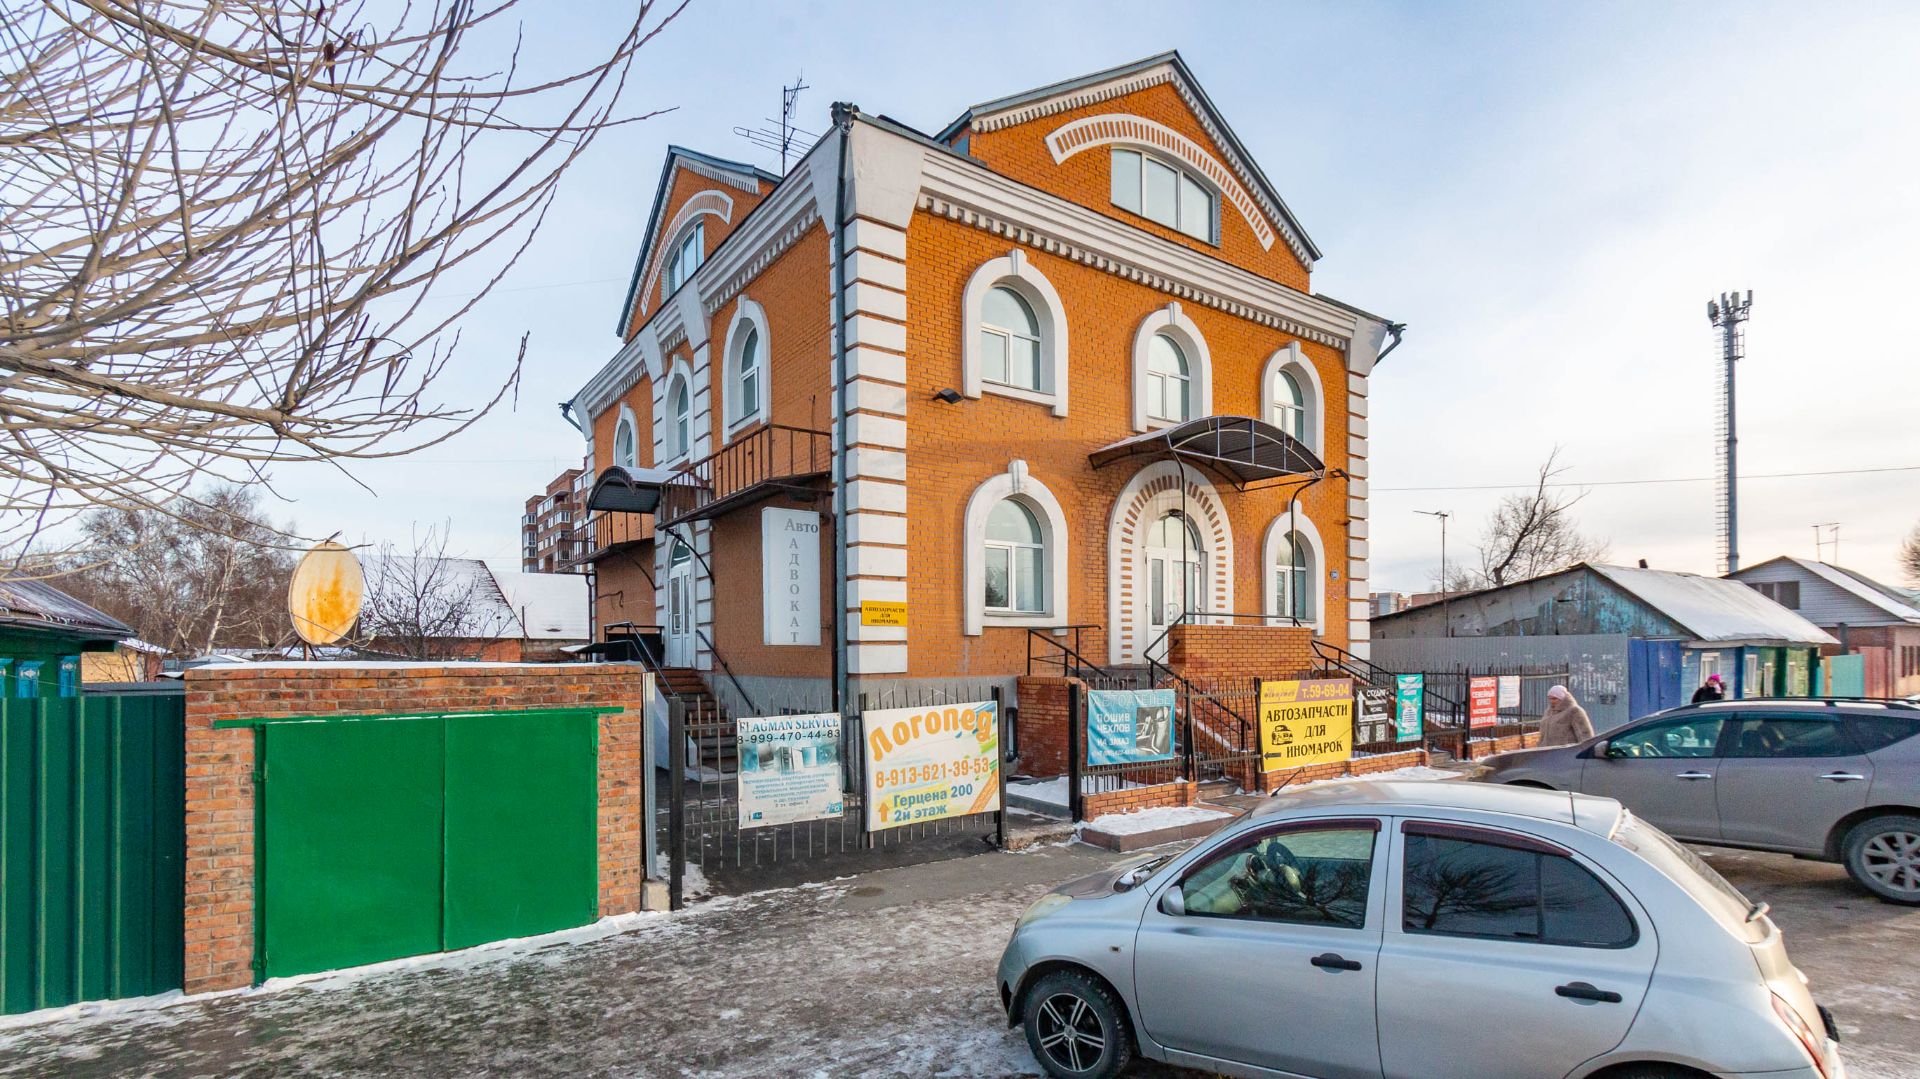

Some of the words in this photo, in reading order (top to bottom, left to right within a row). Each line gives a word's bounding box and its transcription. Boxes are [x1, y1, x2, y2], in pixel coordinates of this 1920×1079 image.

[788, 537, 800, 643] АДВОКАТ
[1096, 712, 1130, 723] ПОШИВ
[1265, 704, 1348, 723] АВТОЗАПЧАСТИ
[739, 721, 793, 733] FLAGMAN
[795, 717, 839, 730] SERVICE
[1096, 723, 1130, 734] ЧЕХЛОВ
[1304, 724, 1327, 739] ДЛЯ
[1286, 740, 1343, 758] ИНОМАРОК
[875, 757, 989, 789] 8-913-621-39-53
[893, 789, 948, 809] Герцена
[951, 783, 973, 799] 200
[914, 803, 947, 819] этаж
